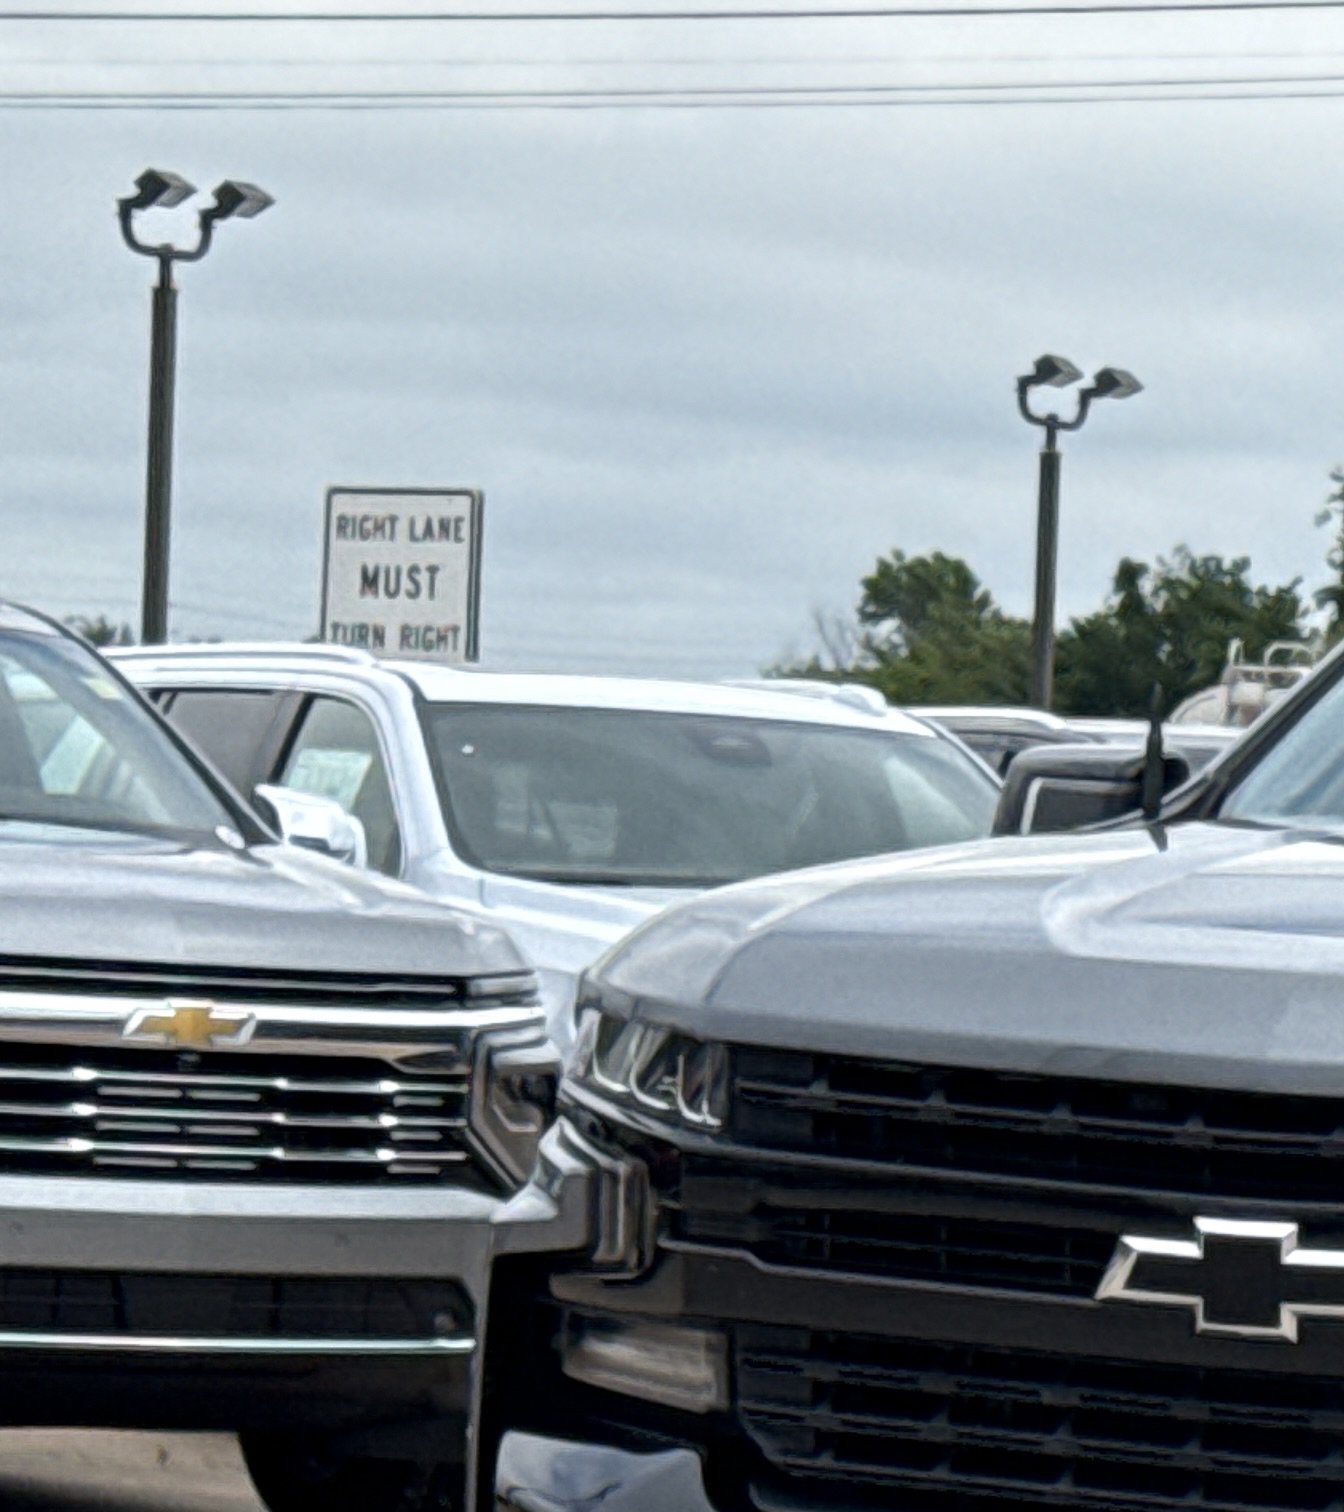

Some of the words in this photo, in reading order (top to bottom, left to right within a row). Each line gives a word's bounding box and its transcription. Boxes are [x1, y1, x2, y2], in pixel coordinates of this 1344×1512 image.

[336, 514, 399, 541] RIGHT
[409, 515, 465, 543] LANE
[359, 562, 440, 600] MUST
[331, 621, 386, 649] TURN
[400, 623, 461, 652] RIGHT
